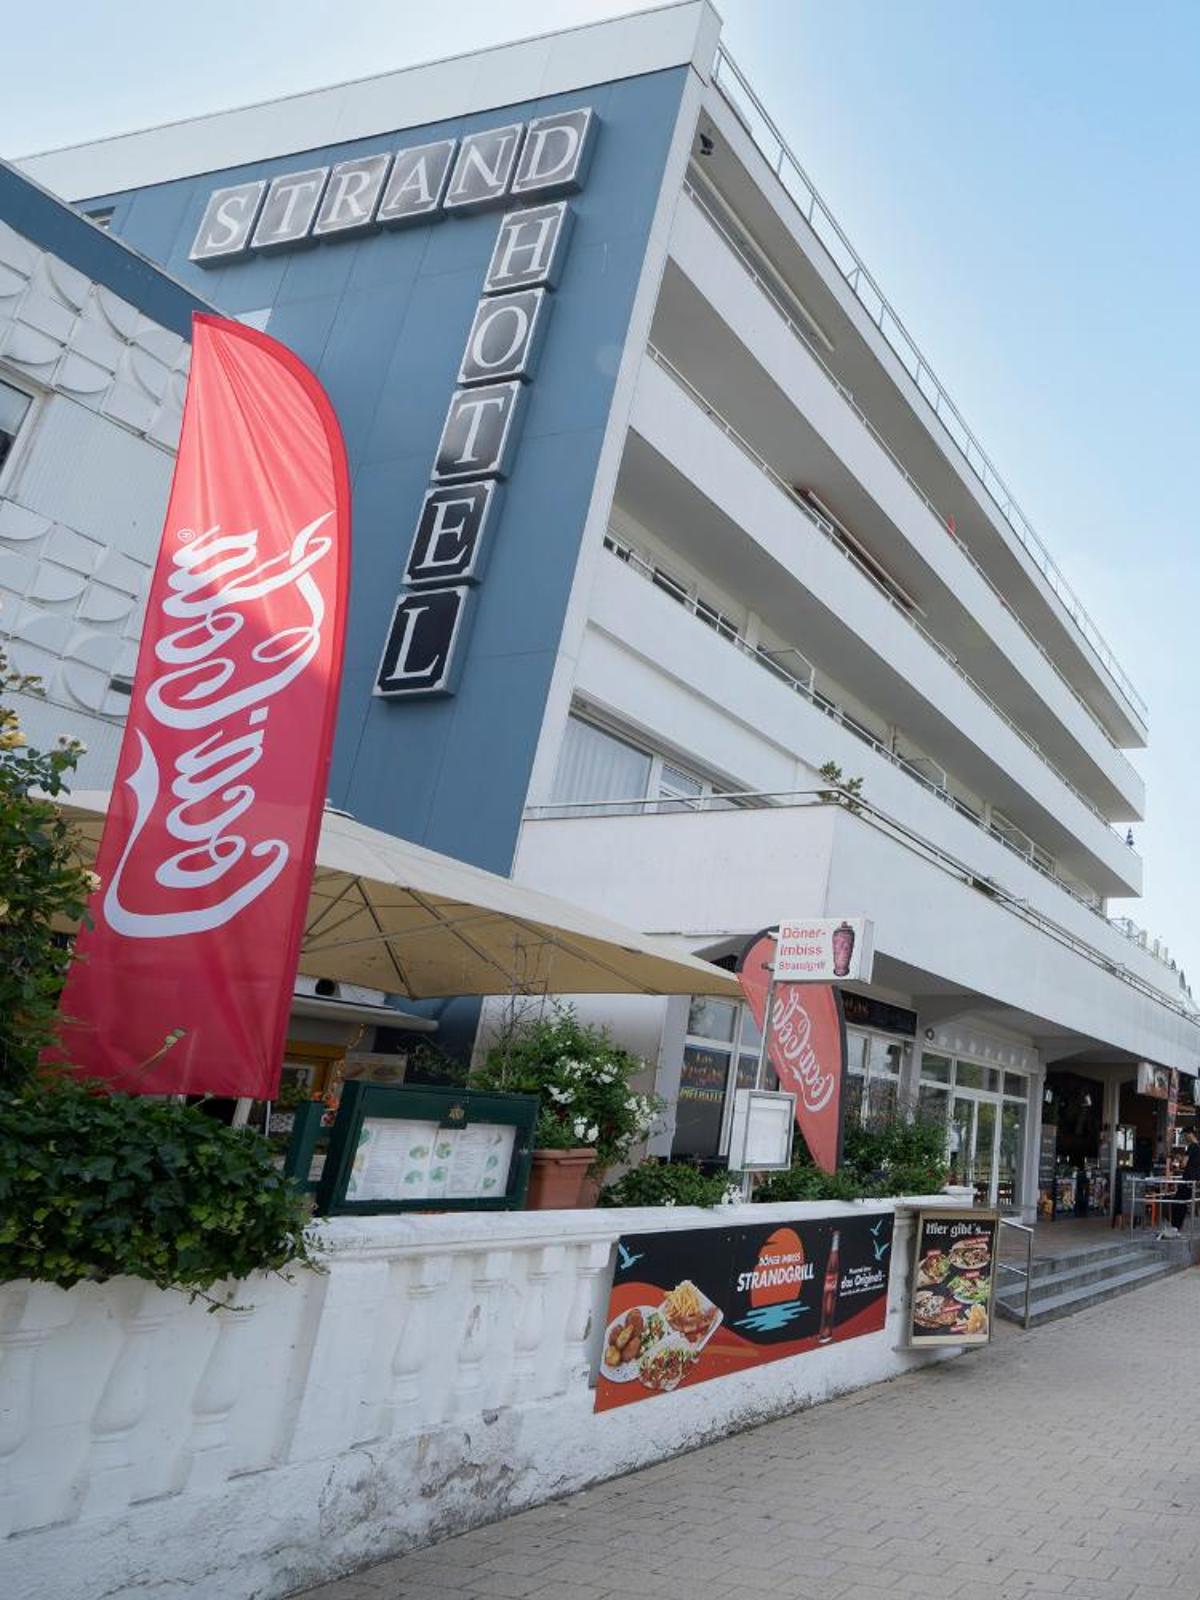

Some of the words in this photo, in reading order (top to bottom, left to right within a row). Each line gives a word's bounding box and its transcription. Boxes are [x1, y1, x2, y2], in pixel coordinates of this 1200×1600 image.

[206, 125, 579, 249] STRAND
[385, 215, 550, 683] HOTEL
[782, 926, 826, 939] Döner-
[780, 943, 823, 956] Imbiss
[925, 1221, 949, 1235] Hier
[736, 1262, 815, 1292] STRANDGRILL
